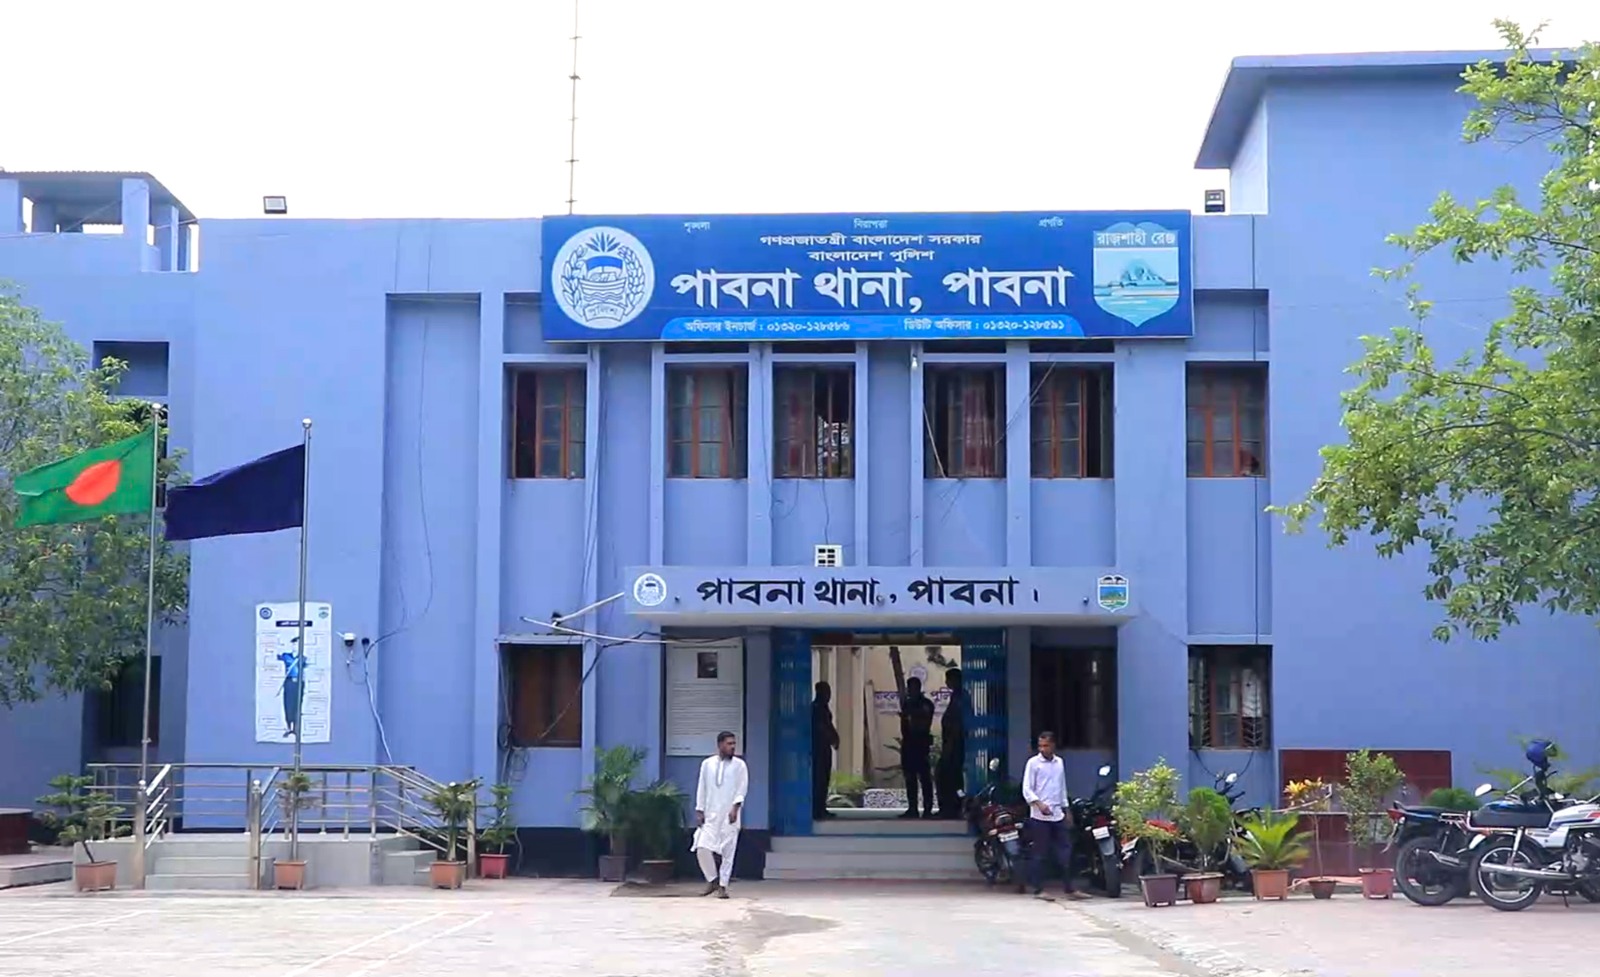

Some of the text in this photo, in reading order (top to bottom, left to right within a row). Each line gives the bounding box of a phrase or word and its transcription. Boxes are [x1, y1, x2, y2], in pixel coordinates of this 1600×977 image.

[851, 234, 923, 246] বাংলাদেশ
[928, 234, 982, 245] সরকার
[1096, 228, 1147, 246] রাজশাহী
[808, 247, 935, 263] বাংলাদেশ পুলিশ
[670, 265, 1074, 313] পাবনা থানা, পাবনা
[697, 577, 806, 606] পাবনা
